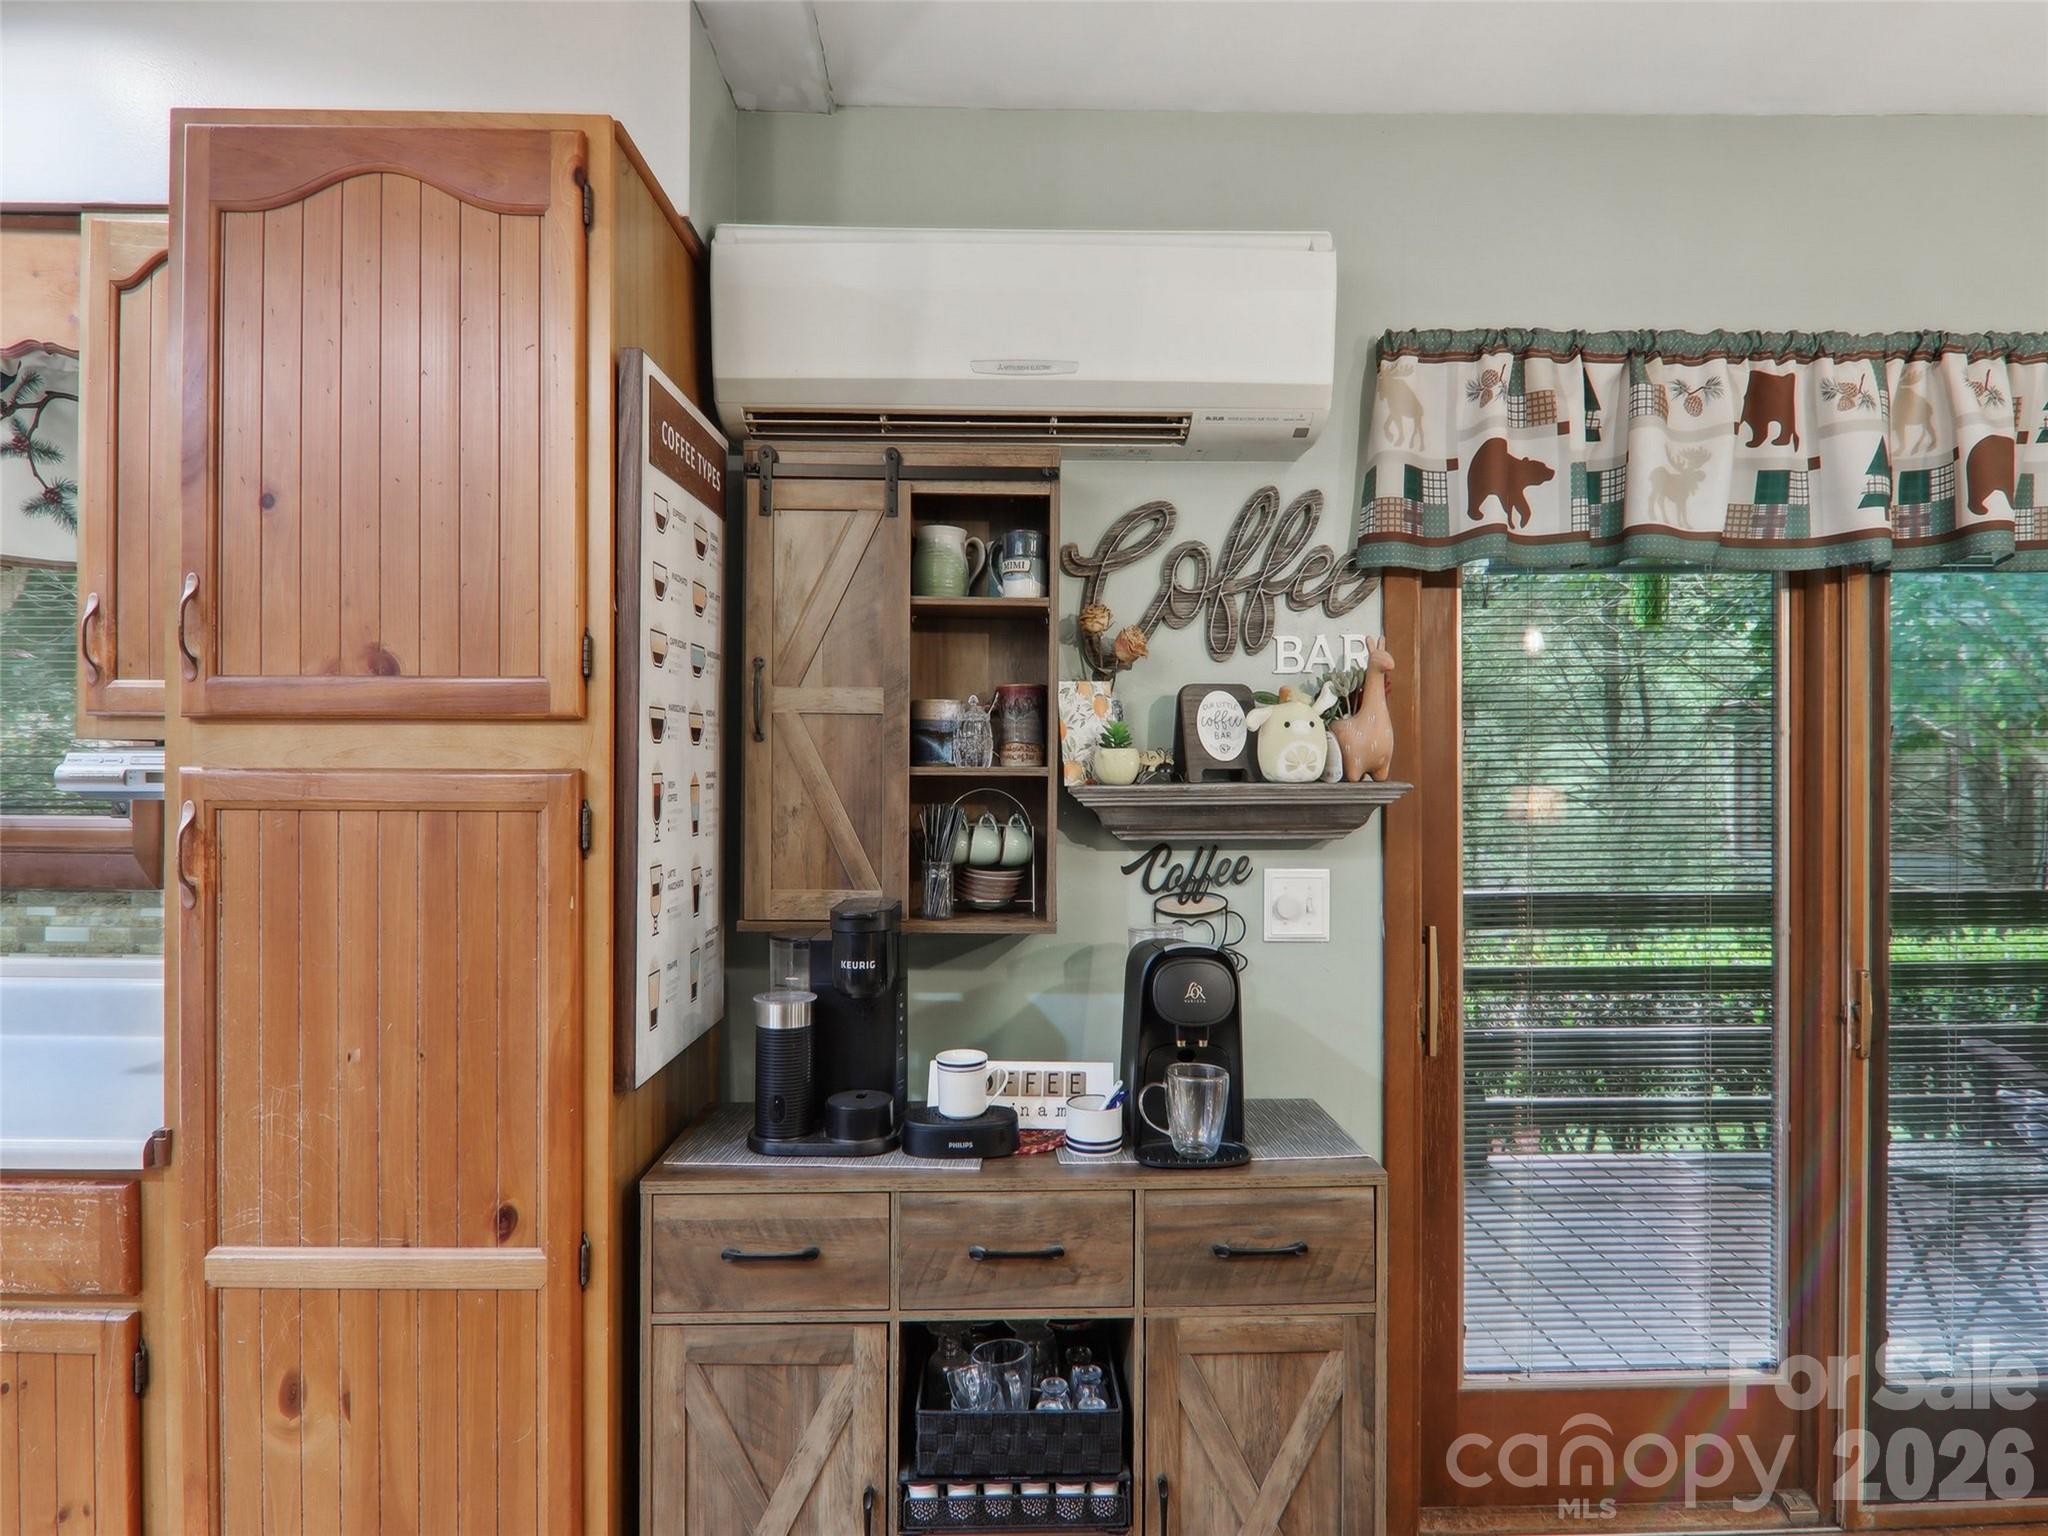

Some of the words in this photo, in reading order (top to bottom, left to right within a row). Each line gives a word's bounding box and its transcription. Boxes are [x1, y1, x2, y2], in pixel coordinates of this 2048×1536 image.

[661, 420, 696, 470] COFFEE
[697, 452, 721, 492] TYPES
[1003, 560, 1025, 570] MIMI
[1061, 485, 1380, 673] Coffee
[1272, 633, 1369, 674] BAR
[1201, 710, 1243, 731] coffee
[1214, 731, 1232, 741] BAR
[1120, 842, 1254, 906] Coffee
[840, 960, 876, 970] KEURIG
[986, 1072, 1082, 1095] FFEE
[948, 1141, 974, 1149] PHILIPS
